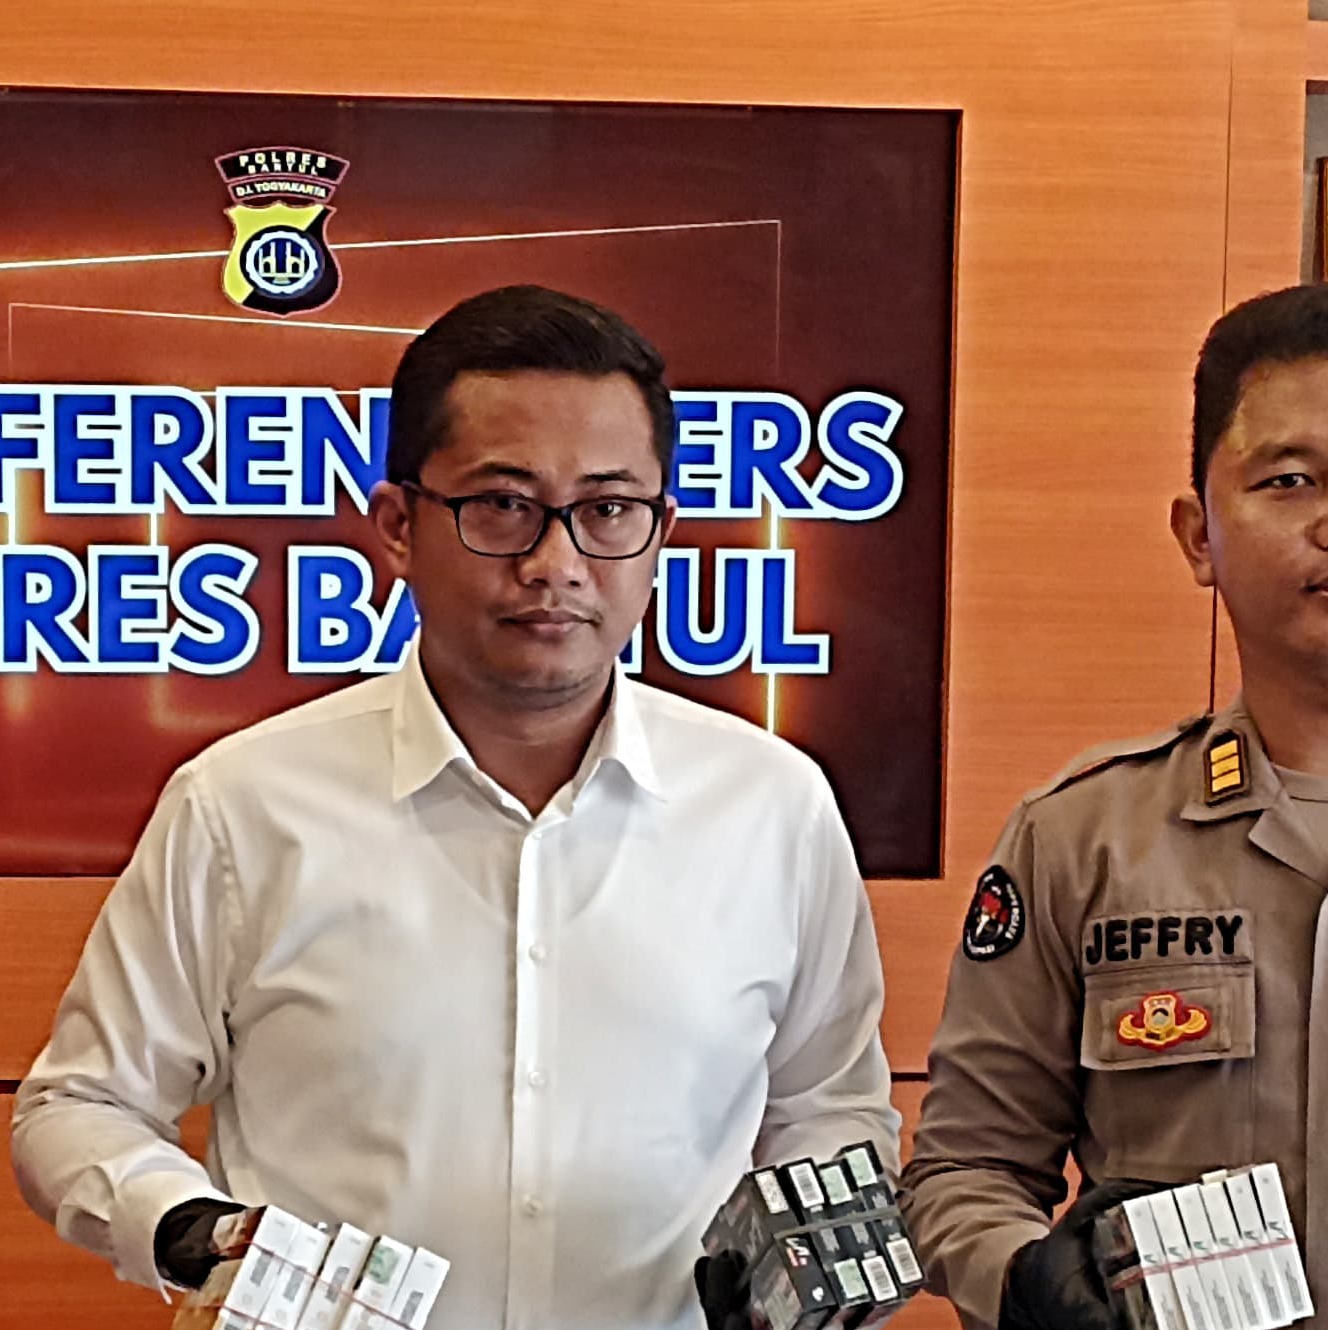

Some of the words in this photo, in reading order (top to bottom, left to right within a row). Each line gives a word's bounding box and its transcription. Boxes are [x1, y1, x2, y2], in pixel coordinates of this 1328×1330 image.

[239, 152, 327, 168] POLRES
[669, 390, 904, 521] ERS
[1086, 915, 1243, 965] JEFFRY
